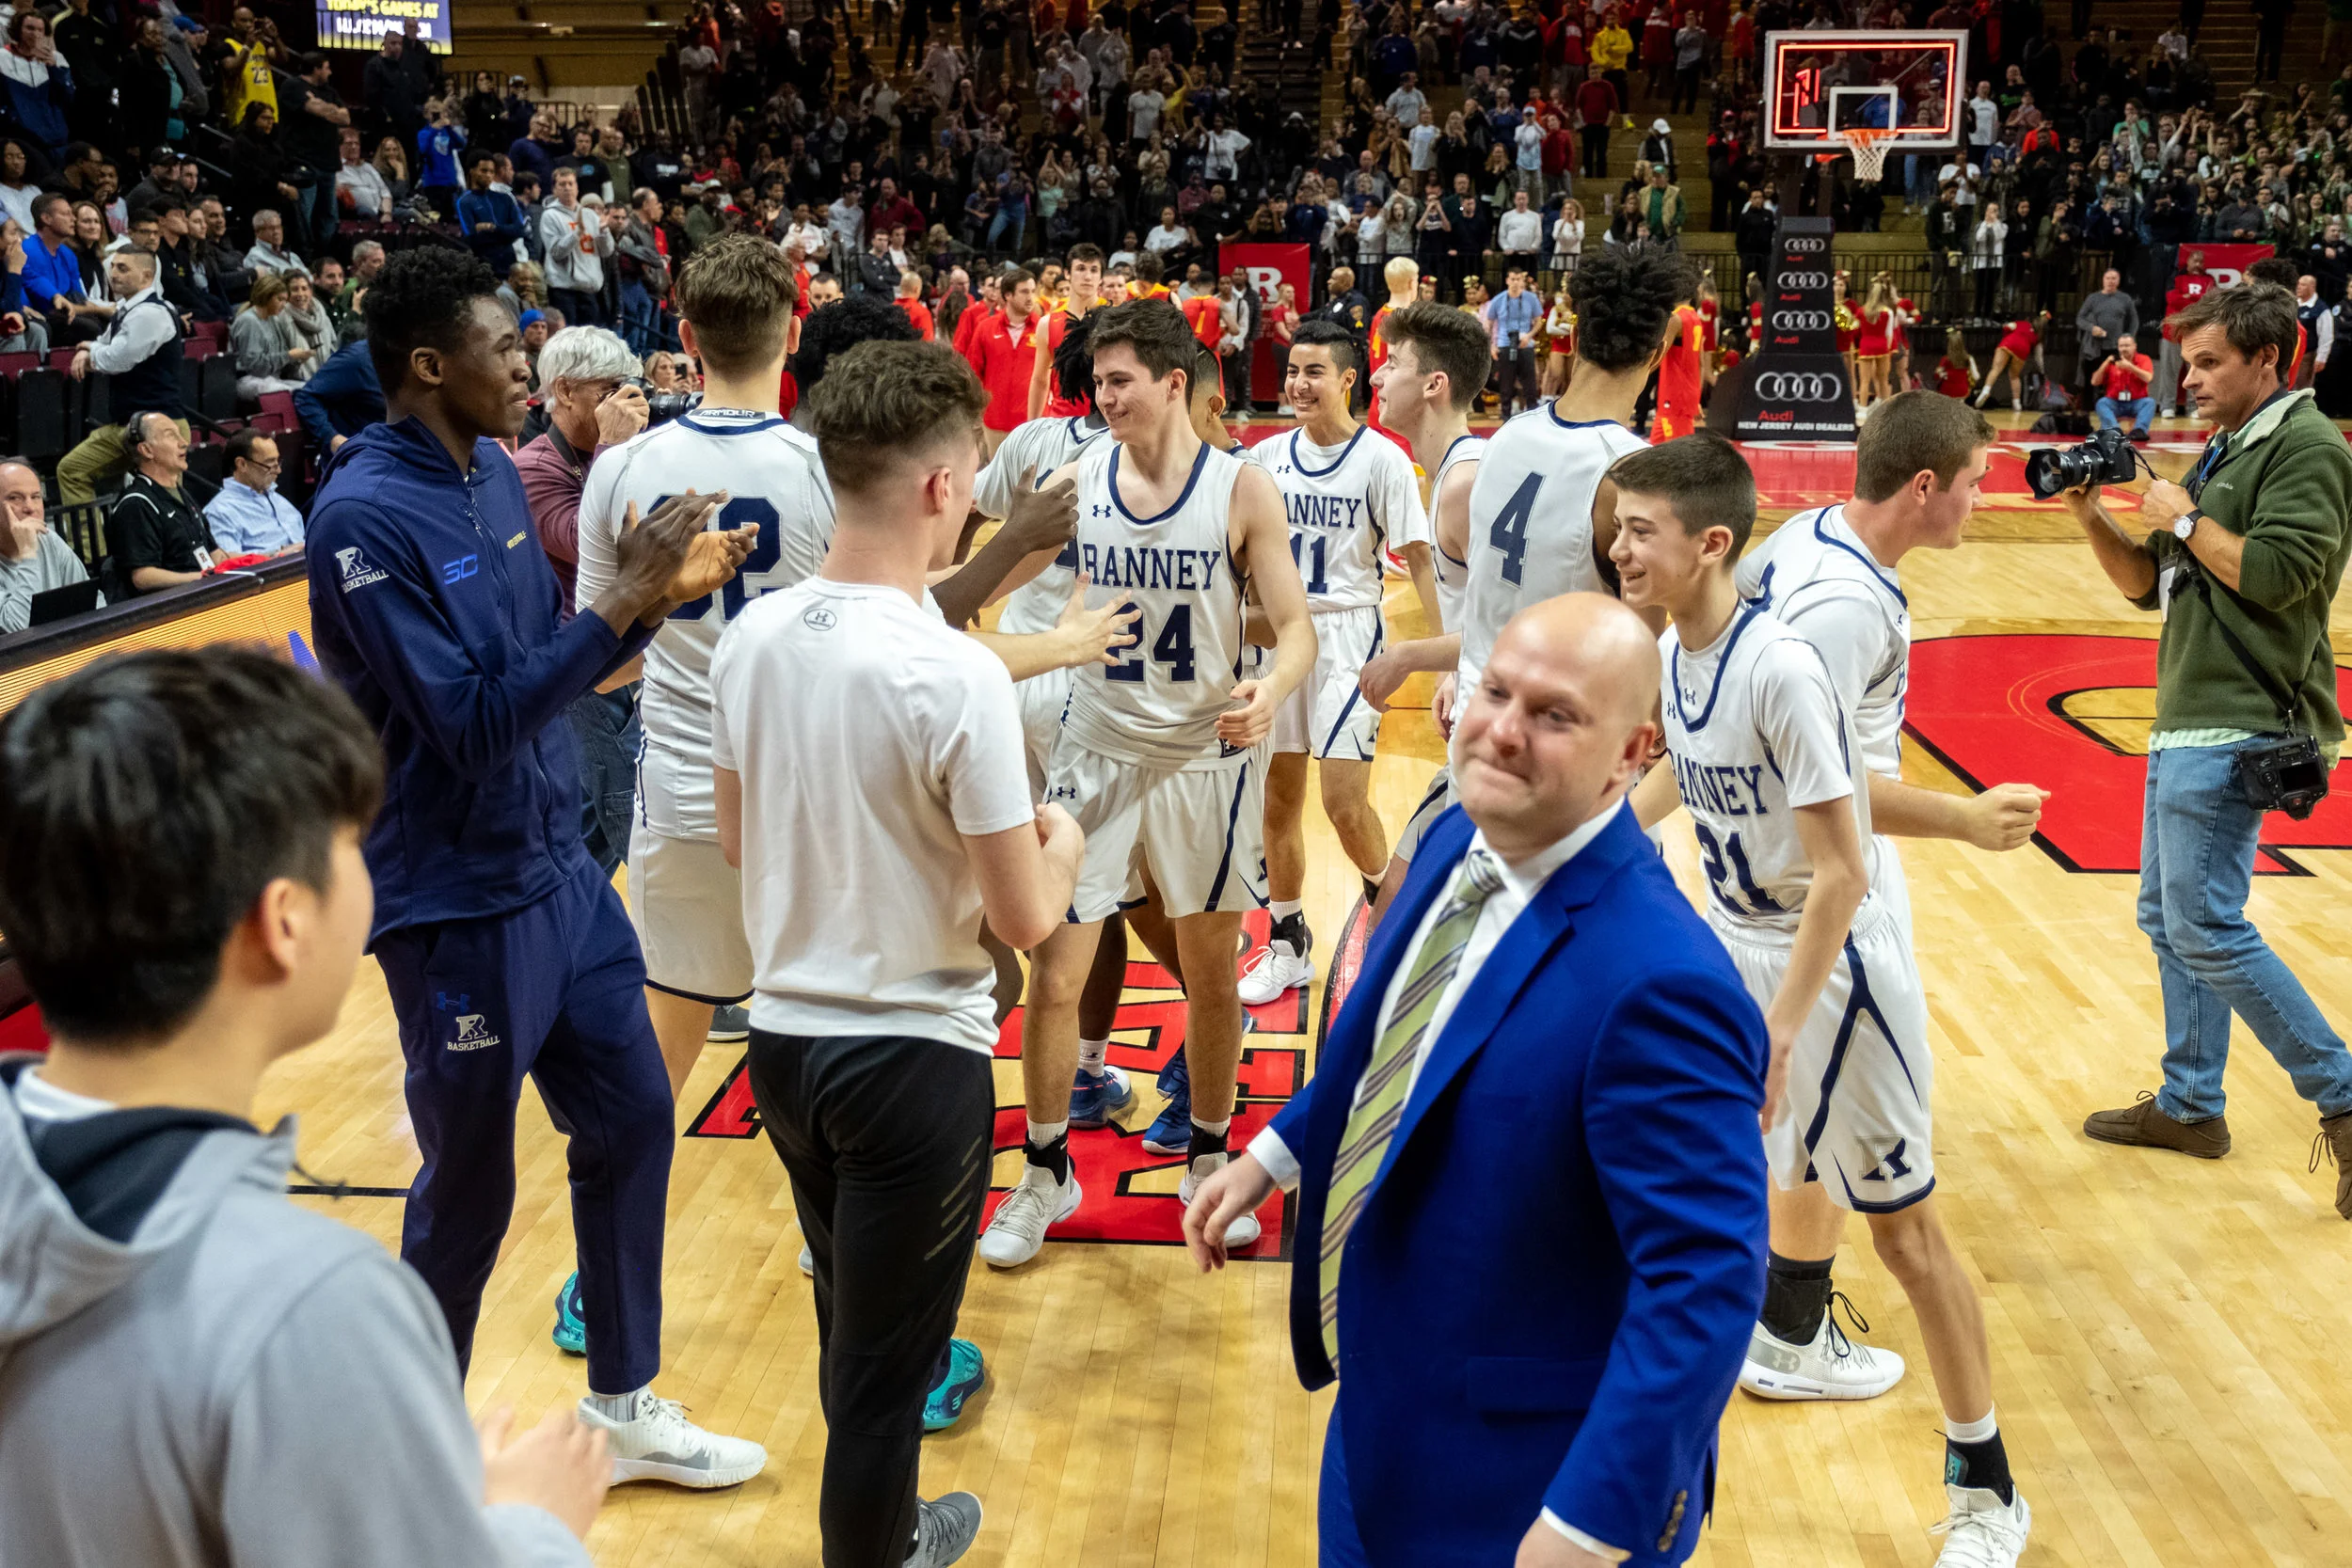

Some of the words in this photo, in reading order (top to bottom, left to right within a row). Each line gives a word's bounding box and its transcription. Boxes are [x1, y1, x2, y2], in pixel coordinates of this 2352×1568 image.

[379, 1, 422, 17] GAMES
[422, 4, 439, 19] AT
[1246, 266, 1282, 303] R
[2188, 283, 2202, 295] R
[1774, 336, 1800, 344] Audi
[699, 409, 755, 419] ARMOUR
[1757, 410, 1794, 422] Audi
[1738, 421, 1758, 430] NEW
[1758, 421, 1793, 431] JERSEY
[1793, 422, 1815, 431] AUDI
[1815, 423, 1855, 432] DEALERS
[1488, 471, 1546, 587] 4
[335, 546, 372, 579] R
[1083, 543, 1221, 590] RANNEY
[1105, 602, 1196, 683] 24
[1694, 821, 1788, 916] 21
[456, 1014, 488, 1041] R
[447, 1036, 501, 1052] BASKETBALL
